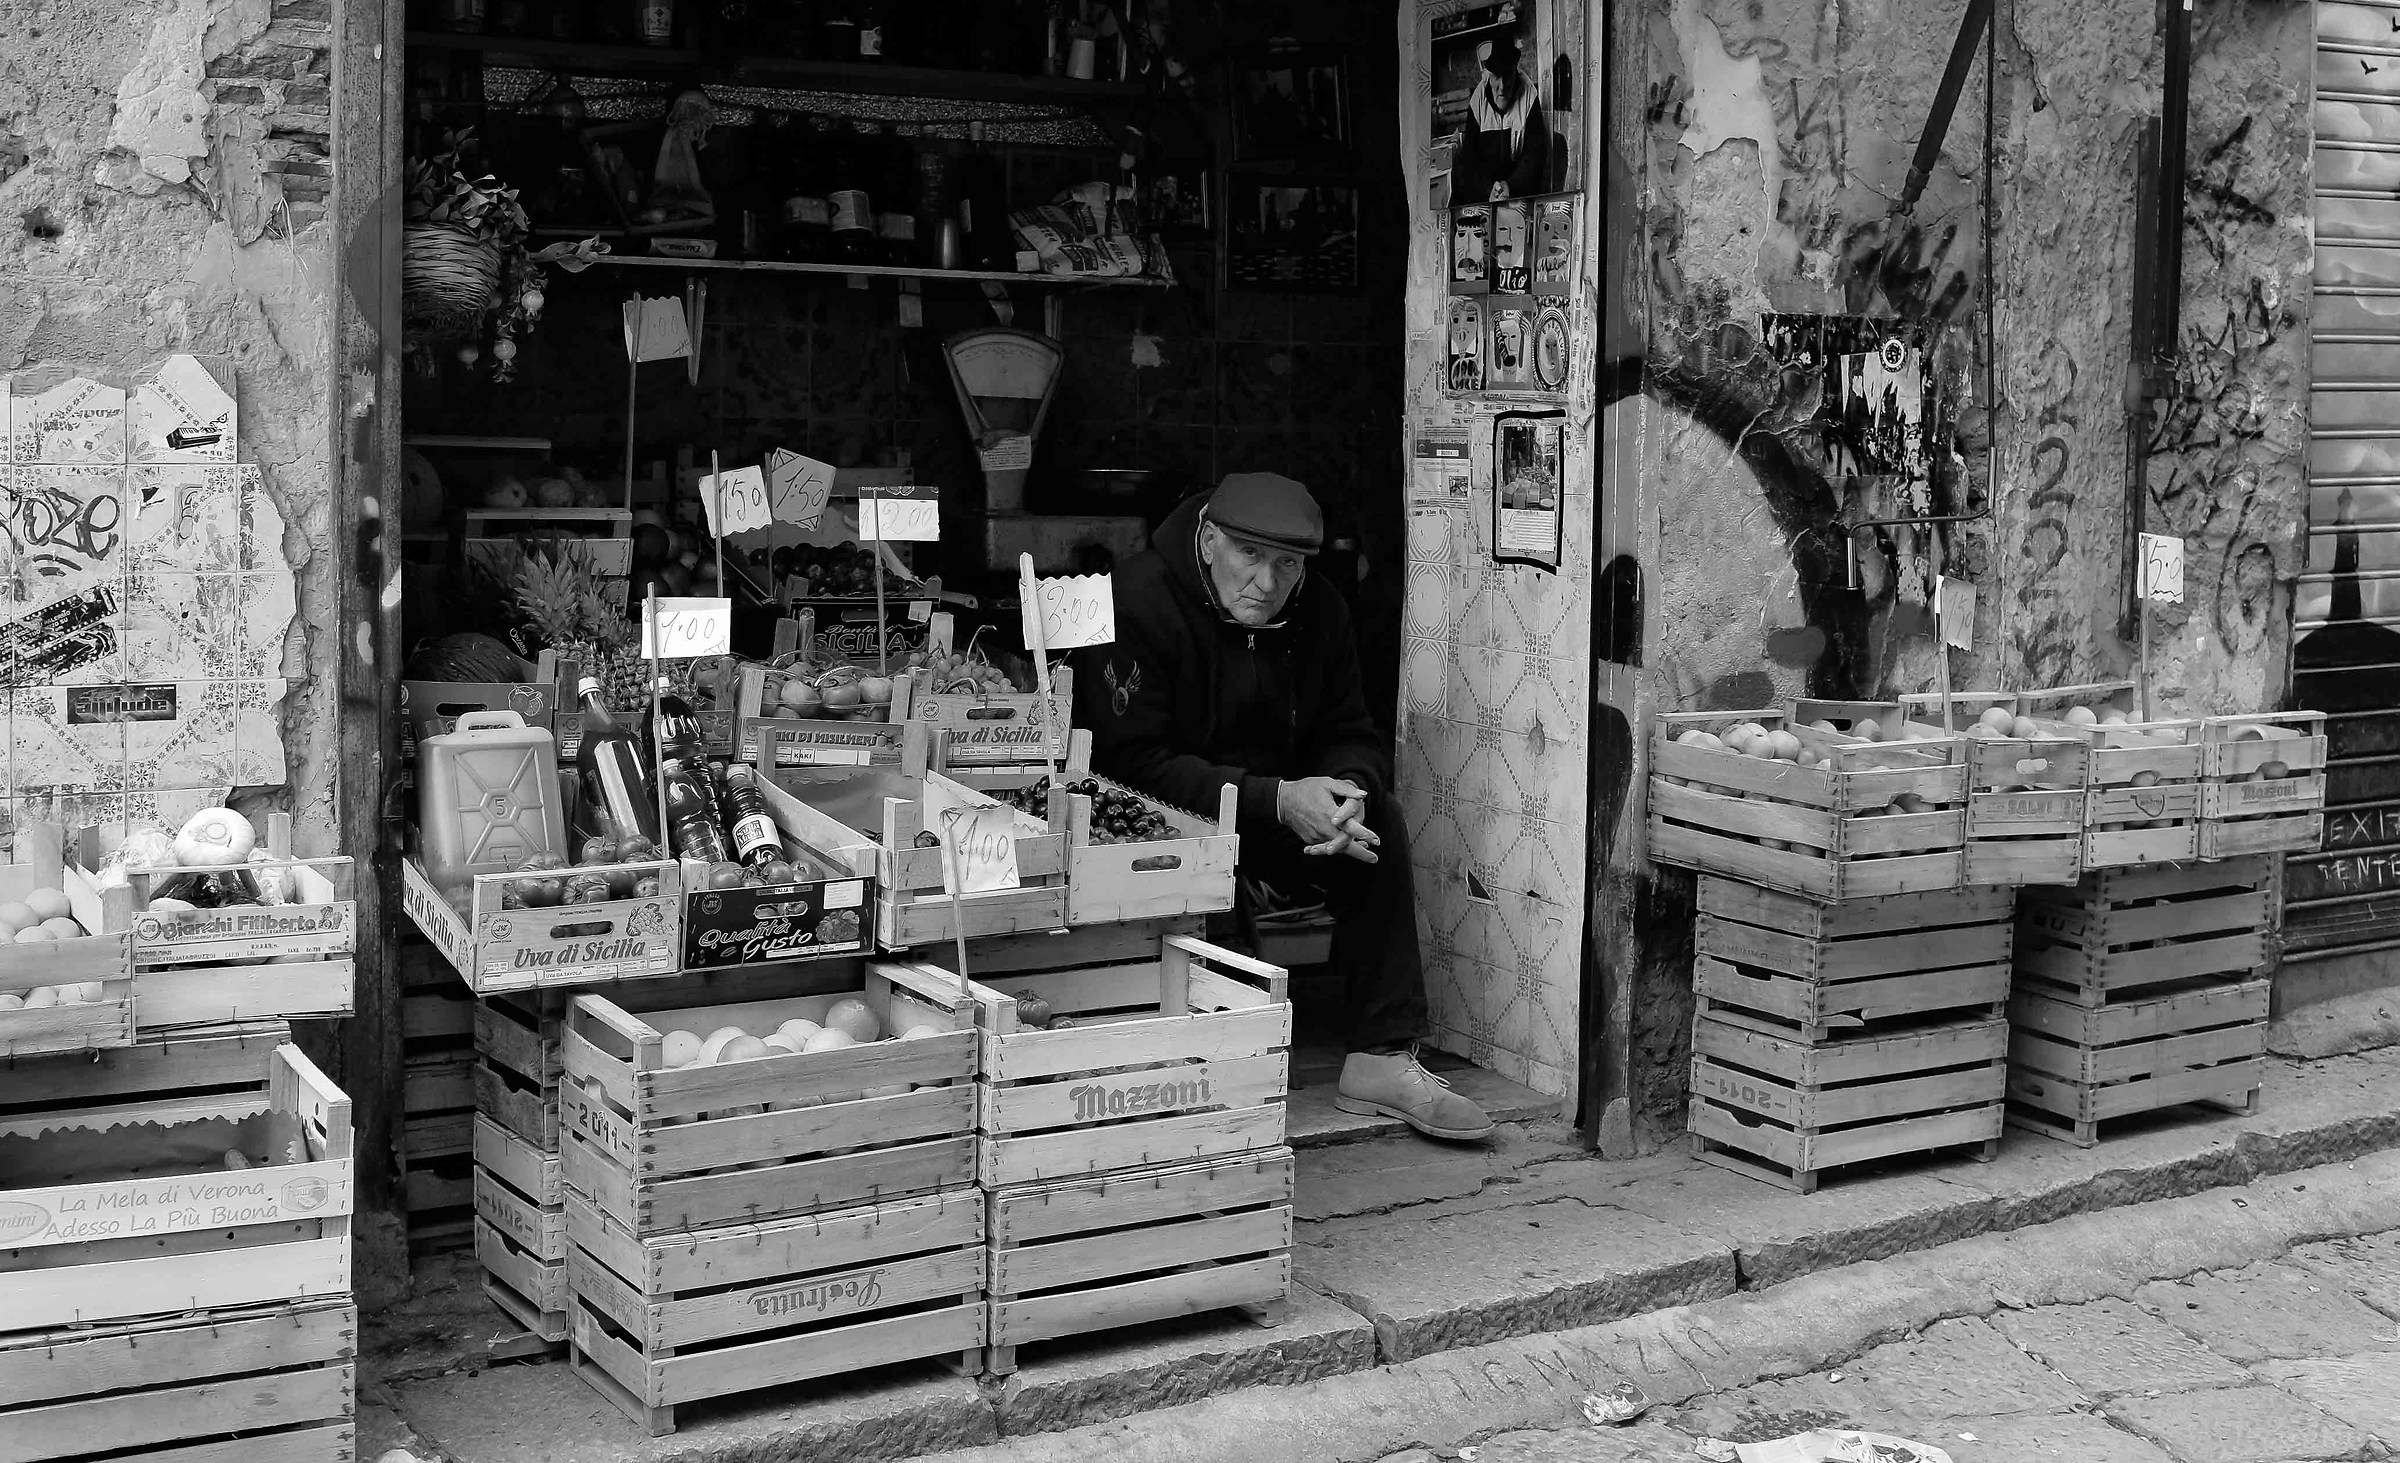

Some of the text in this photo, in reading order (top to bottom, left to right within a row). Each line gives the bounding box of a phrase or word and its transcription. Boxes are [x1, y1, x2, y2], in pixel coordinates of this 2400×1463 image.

[814, 633, 907, 652] SICILA
[776, 731, 878, 746] AKI DI MISILMERI
[971, 726, 991, 744] di
[991, 726, 1043, 744] Sicilia
[794, 752, 812, 760] KAKI
[495, 798, 507, 817] 5
[237, 914, 317, 932] Filiberto
[425, 900, 454, 952] Sicilia
[698, 917, 792, 950] Qualità
[514, 937, 646, 968] Uva di Sicilia
[742, 929, 813, 960] Gusto
[1068, 1068, 1213, 1123] Mazzoni
[59, 1196, 86, 1214] La
[96, 1188, 148, 1210] Mela
[158, 1183, 181, 1204] di
[187, 1180, 267, 1202] Verona
[42, 1203, 279, 1240] Adesso La Più Buona
